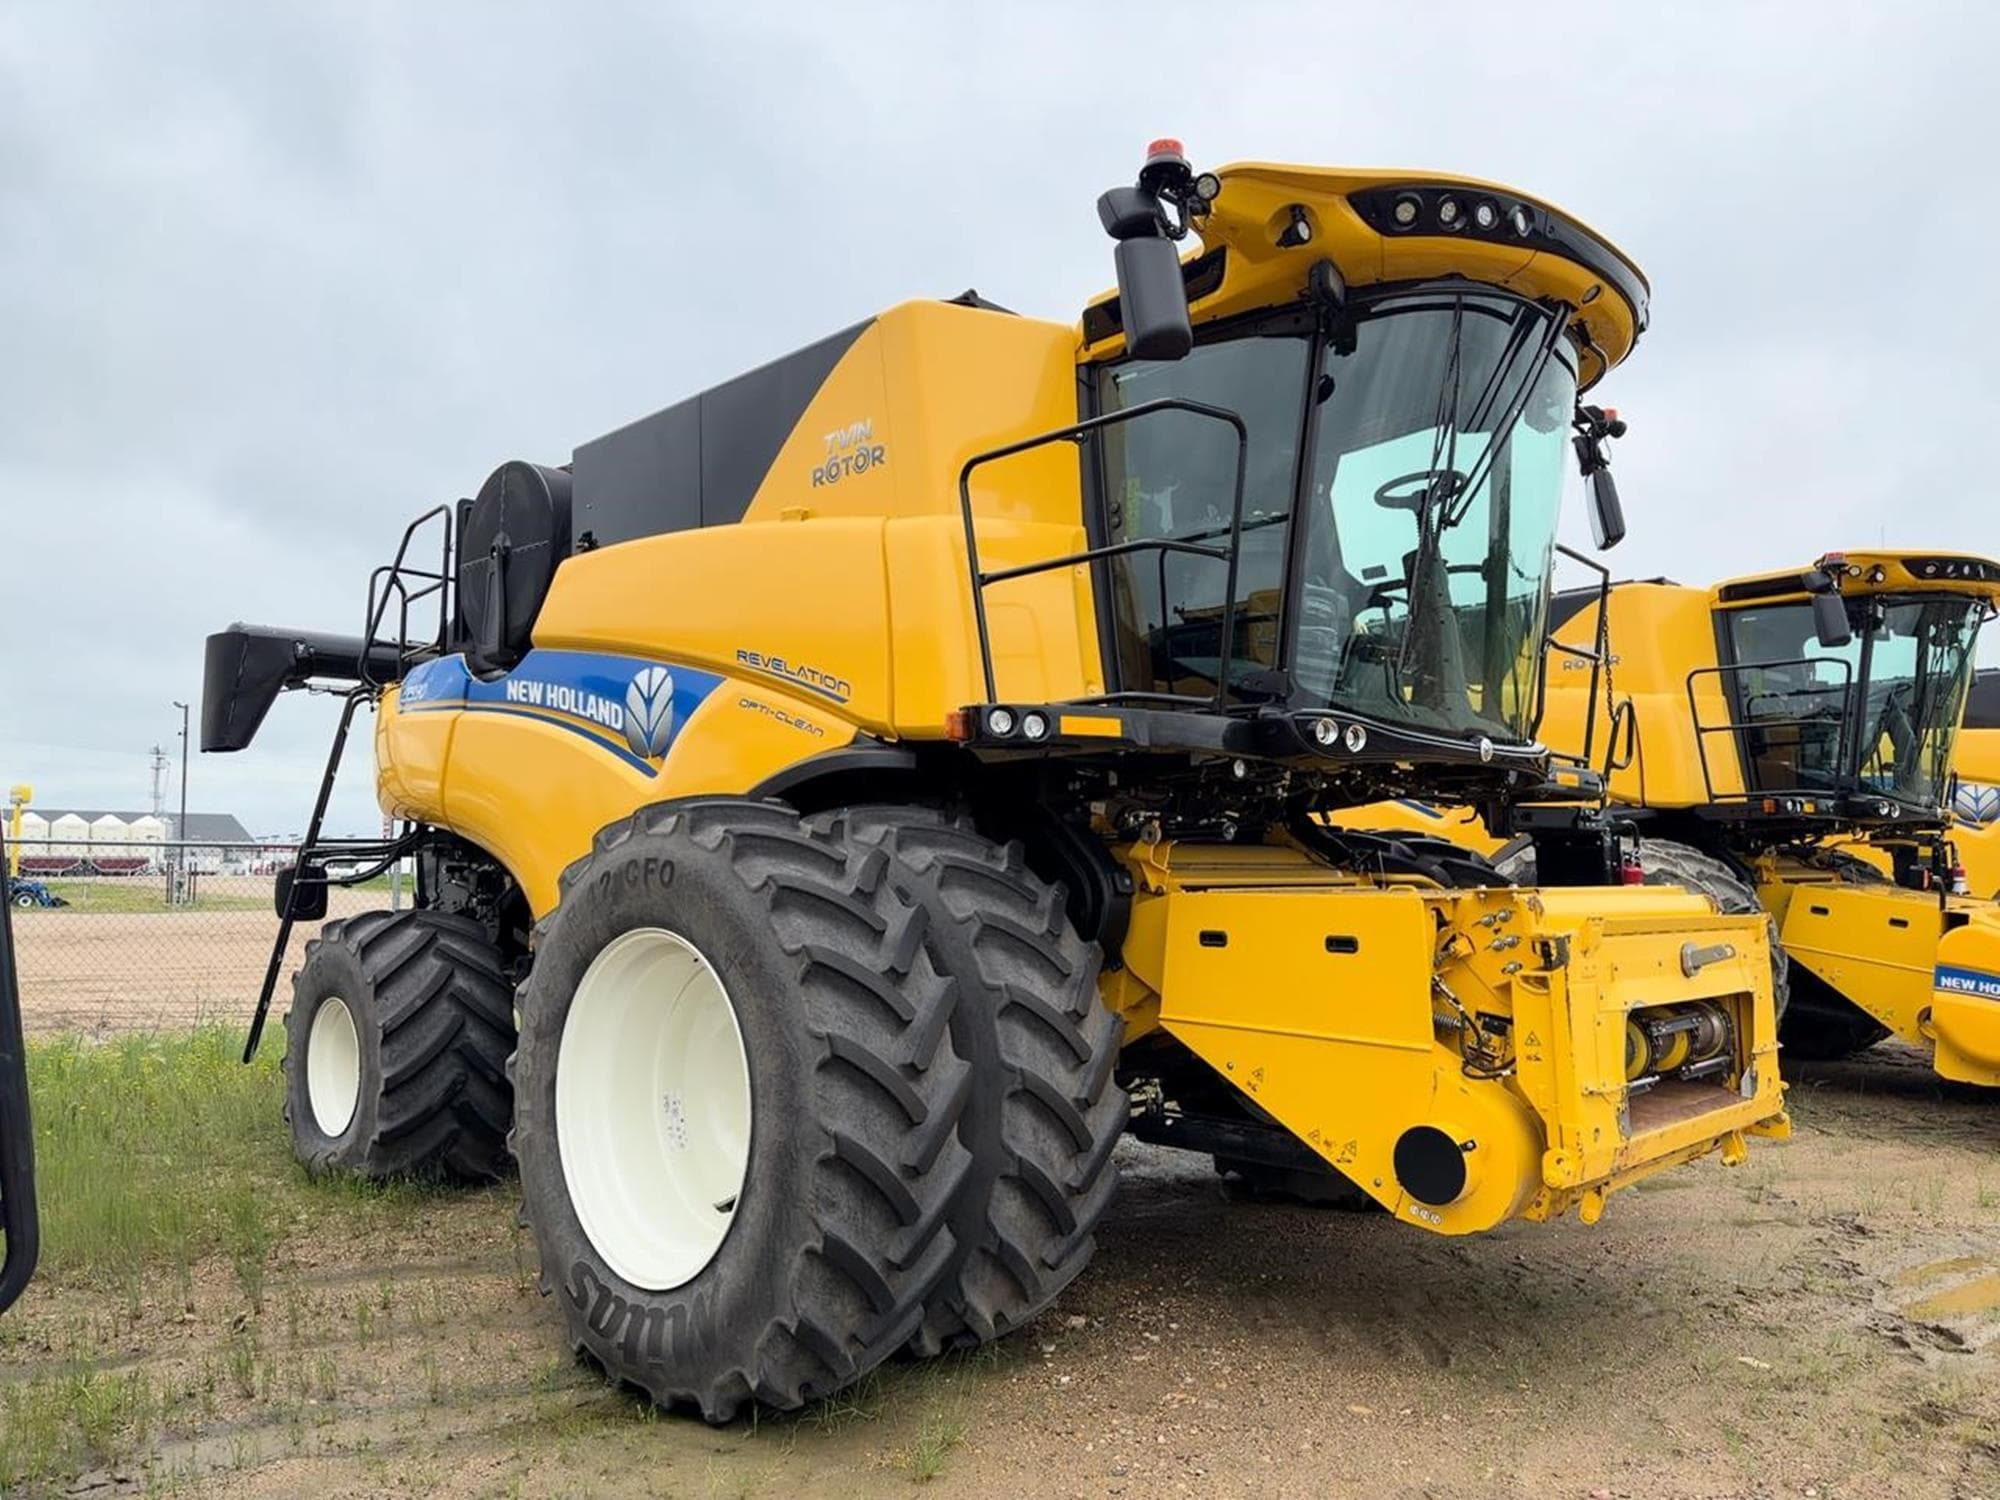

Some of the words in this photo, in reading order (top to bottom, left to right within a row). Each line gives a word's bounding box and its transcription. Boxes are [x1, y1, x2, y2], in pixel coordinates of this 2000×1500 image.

[824, 419, 873, 453] TWIN
[812, 445, 886, 488] ROTOR
[736, 650, 851, 697] REVELATION
[506, 680, 543, 704] NEW
[546, 683, 623, 731] HOLLAND
[1940, 975, 1976, 991] NEW
